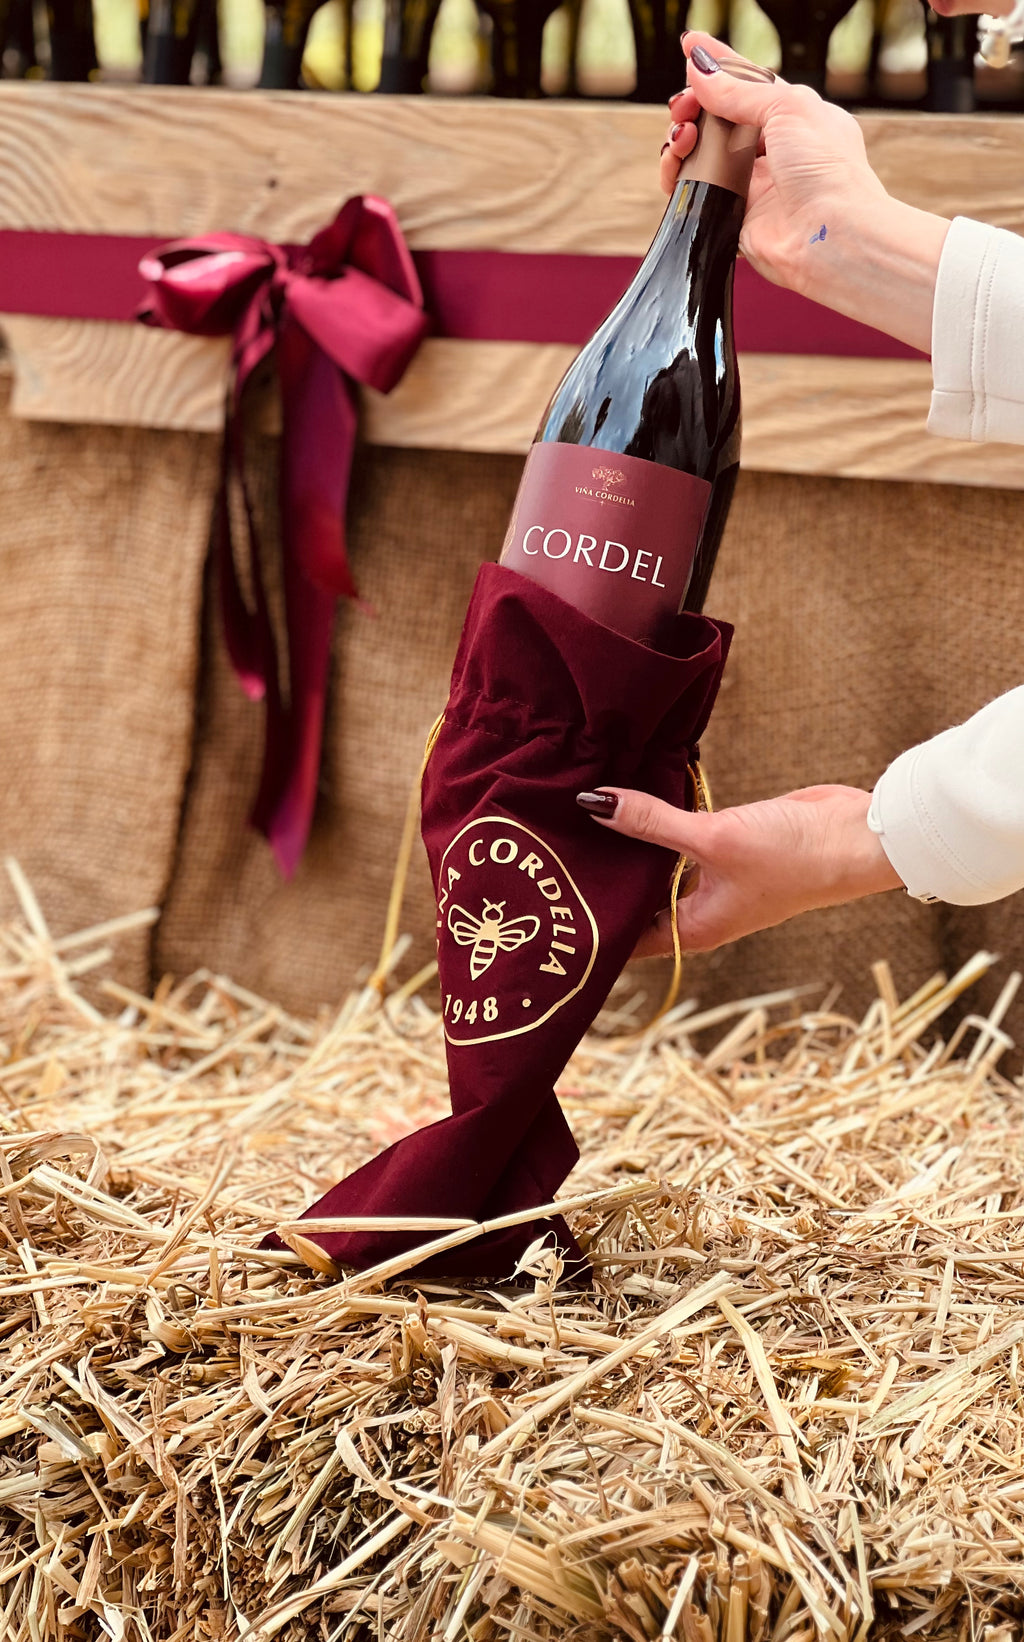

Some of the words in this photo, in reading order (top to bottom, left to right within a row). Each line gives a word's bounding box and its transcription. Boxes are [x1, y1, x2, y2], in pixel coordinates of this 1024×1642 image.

[595, 491, 635, 507] CORDELIA
[522, 525, 666, 588] CORDEL
[468, 838, 577, 976] CORDELIA
[444, 994, 499, 1025] 1948
